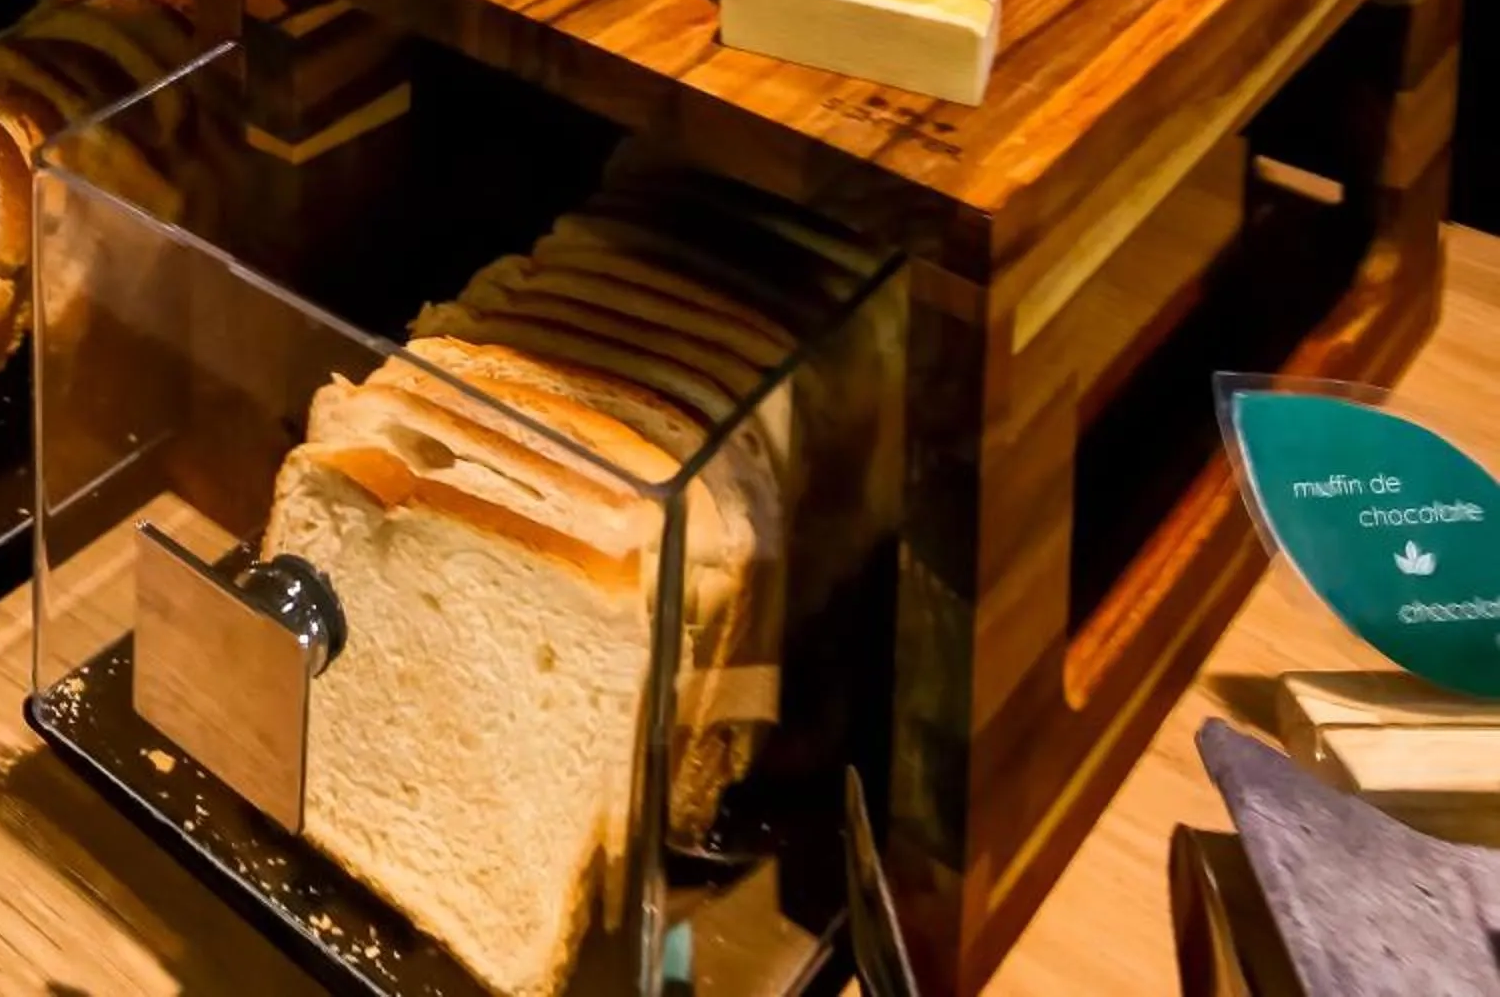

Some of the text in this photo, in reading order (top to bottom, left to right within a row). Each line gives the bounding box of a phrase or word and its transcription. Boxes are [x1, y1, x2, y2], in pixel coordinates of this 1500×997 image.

[1292, 471, 1402, 499] muffin de
[1358, 499, 1485, 528] chocolate
